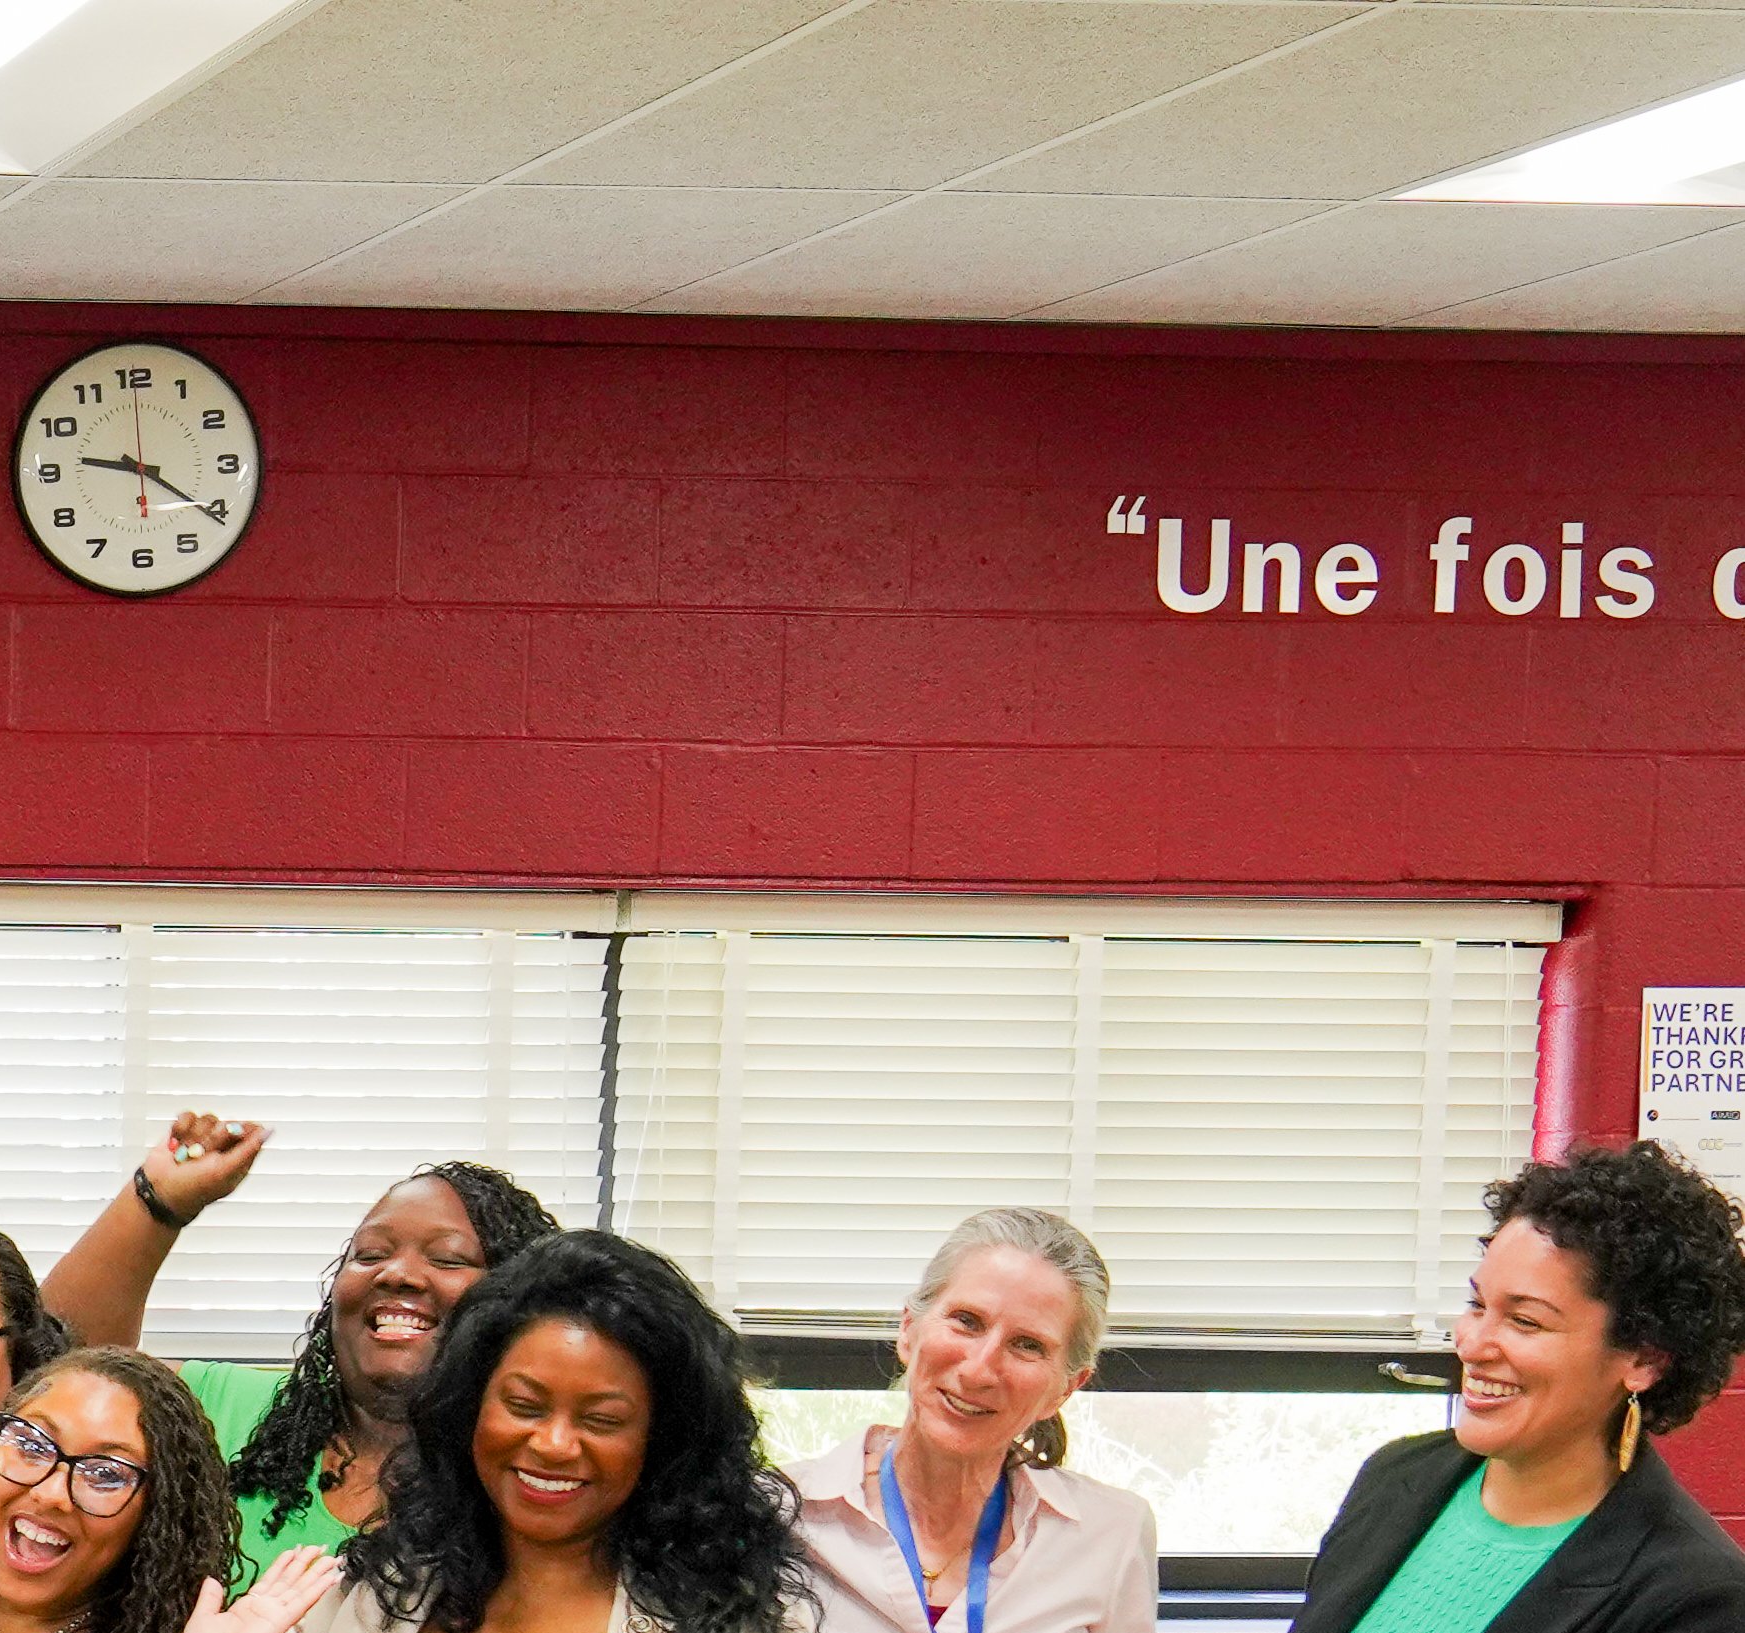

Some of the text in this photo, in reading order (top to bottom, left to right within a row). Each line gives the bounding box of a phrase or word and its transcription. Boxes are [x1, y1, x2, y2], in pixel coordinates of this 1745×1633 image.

[115, 368, 152, 389] 12
[74, 384, 102, 404] 11
[175, 379, 187, 399] 1
[40, 417, 77, 437] 10
[203, 410, 225, 429] 2
[39, 464, 61, 483] 9
[217, 454, 240, 474] 3
[54, 507, 75, 527] 8
[207, 499, 229, 518] 4
[86, 538, 107, 558] 7
[177, 533, 198, 554] 5
[132, 549, 154, 568] 6
[1429, 516, 1656, 620] fois
[1653, 1003, 1734, 1022] WE’RE
[1652, 1049, 1745, 1069] FOR GR
[1651, 1073, 1745, 1092] PARTNE
